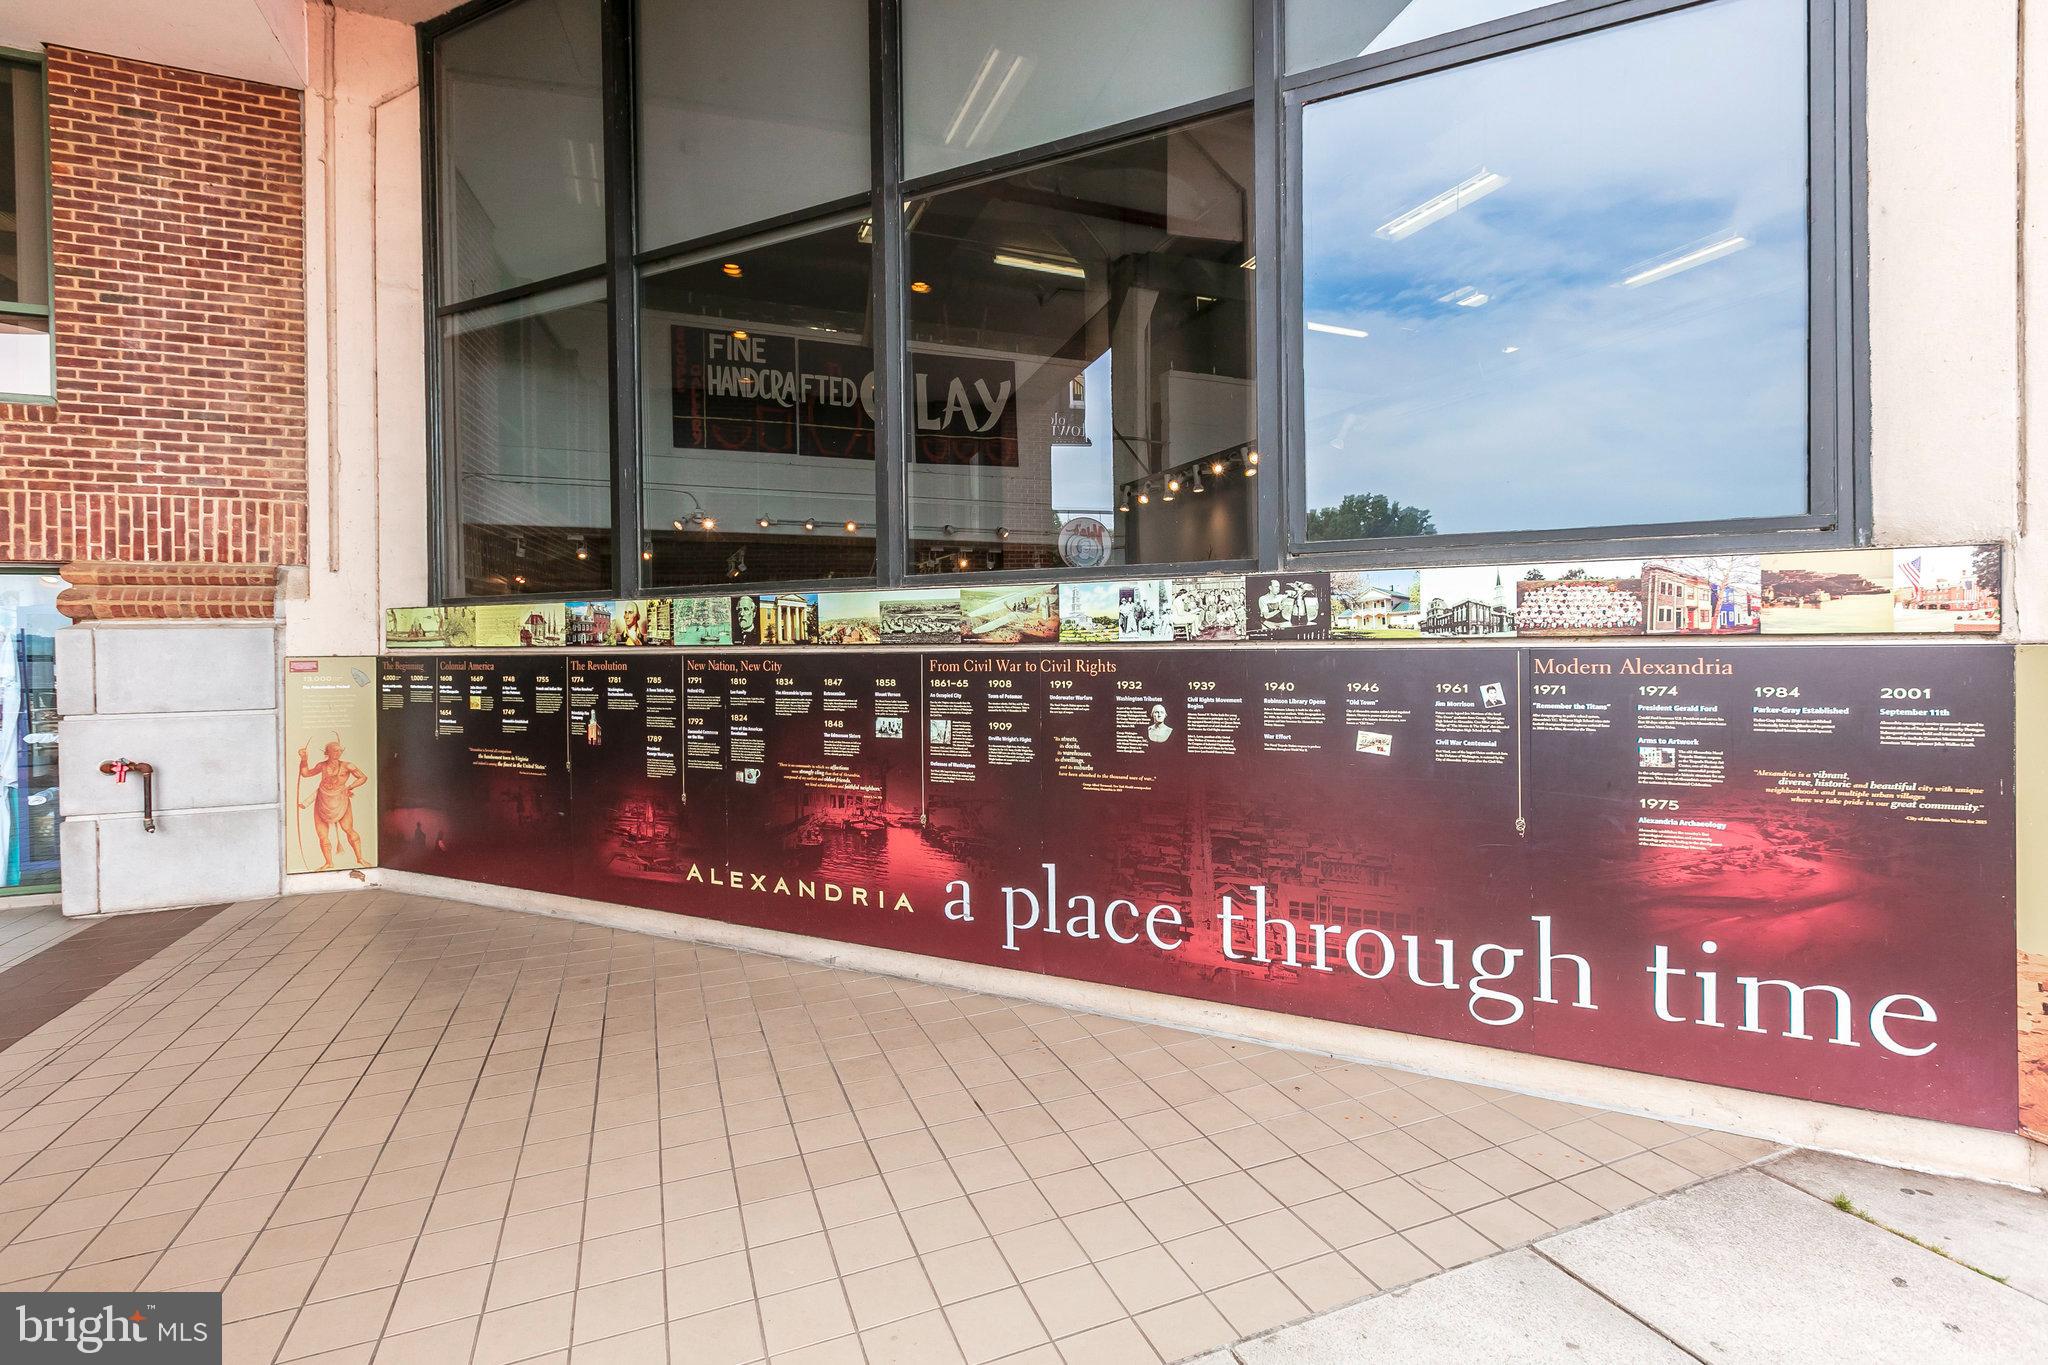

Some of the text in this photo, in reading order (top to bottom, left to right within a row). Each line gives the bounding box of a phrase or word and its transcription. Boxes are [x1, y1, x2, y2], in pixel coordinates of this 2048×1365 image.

[708, 332, 767, 364] FINE
[707, 364, 858, 408] HANDCRAFTED
[383, 661, 425, 672] The Beginning
[440, 661, 495, 671] Colonial America
[571, 660, 628, 671] The Revolution
[687, 660, 782, 674] New Nation, New City
[930, 659, 1117, 676] From Civil War to Civil Rights
[1534, 657, 1734, 675] Modern Alexandria
[775, 678, 794, 686] 1834
[875, 679, 896, 687] 1858
[988, 680, 1012, 688] 1908
[1049, 680, 1073, 689] 1919
[1116, 681, 1143, 690] 1932
[1188, 681, 1216, 691] 1939
[1264, 682, 1295, 692] 1940
[1346, 682, 1380, 693] 1946
[1435, 684, 1469, 694] 1961
[1533, 684, 1566, 695] 1971
[1638, 685, 1679, 697] 1974
[1753, 686, 1800, 698] 1984
[1880, 687, 1932, 700] 2001
[1263, 697, 1326, 706] Robinson Library Opens
[1637, 704, 1673, 712] President
[1699, 705, 1718, 713] Ford
[1753, 706, 1850, 715] Parker-Gray Established
[1880, 708, 1950, 717] September 11th
[824, 720, 844, 728] 1848
[988, 722, 1013, 731] 1909
[646, 735, 662, 743] 1789
[1637, 737, 1657, 745] Arms
[1668, 738, 1699, 746] Artwork
[1812, 770, 1850, 780] vibrant,
[1778, 777, 1813, 787] diverse,
[1815, 778, 1852, 788] historic
[1870, 781, 1917, 792] beautiful
[1918, 784, 1933, 793] city
[1935, 785, 1953, 793] with
[1955, 786, 1984, 795] unique
[1765, 786, 1819, 795] neighborhoods
[1837, 789, 1870, 799] multiple
[1871, 791, 1895, 799] urban
[1895, 792, 1926, 801] villages
[1639, 798, 1680, 811] 1975
[1843, 798, 1864, 807] pride
[1889, 801, 1917, 810] great
[1638, 817, 1727, 830] Alexandria Archaeology
[686, 863, 1939, 1057] ALEXANDRIA a place through time
